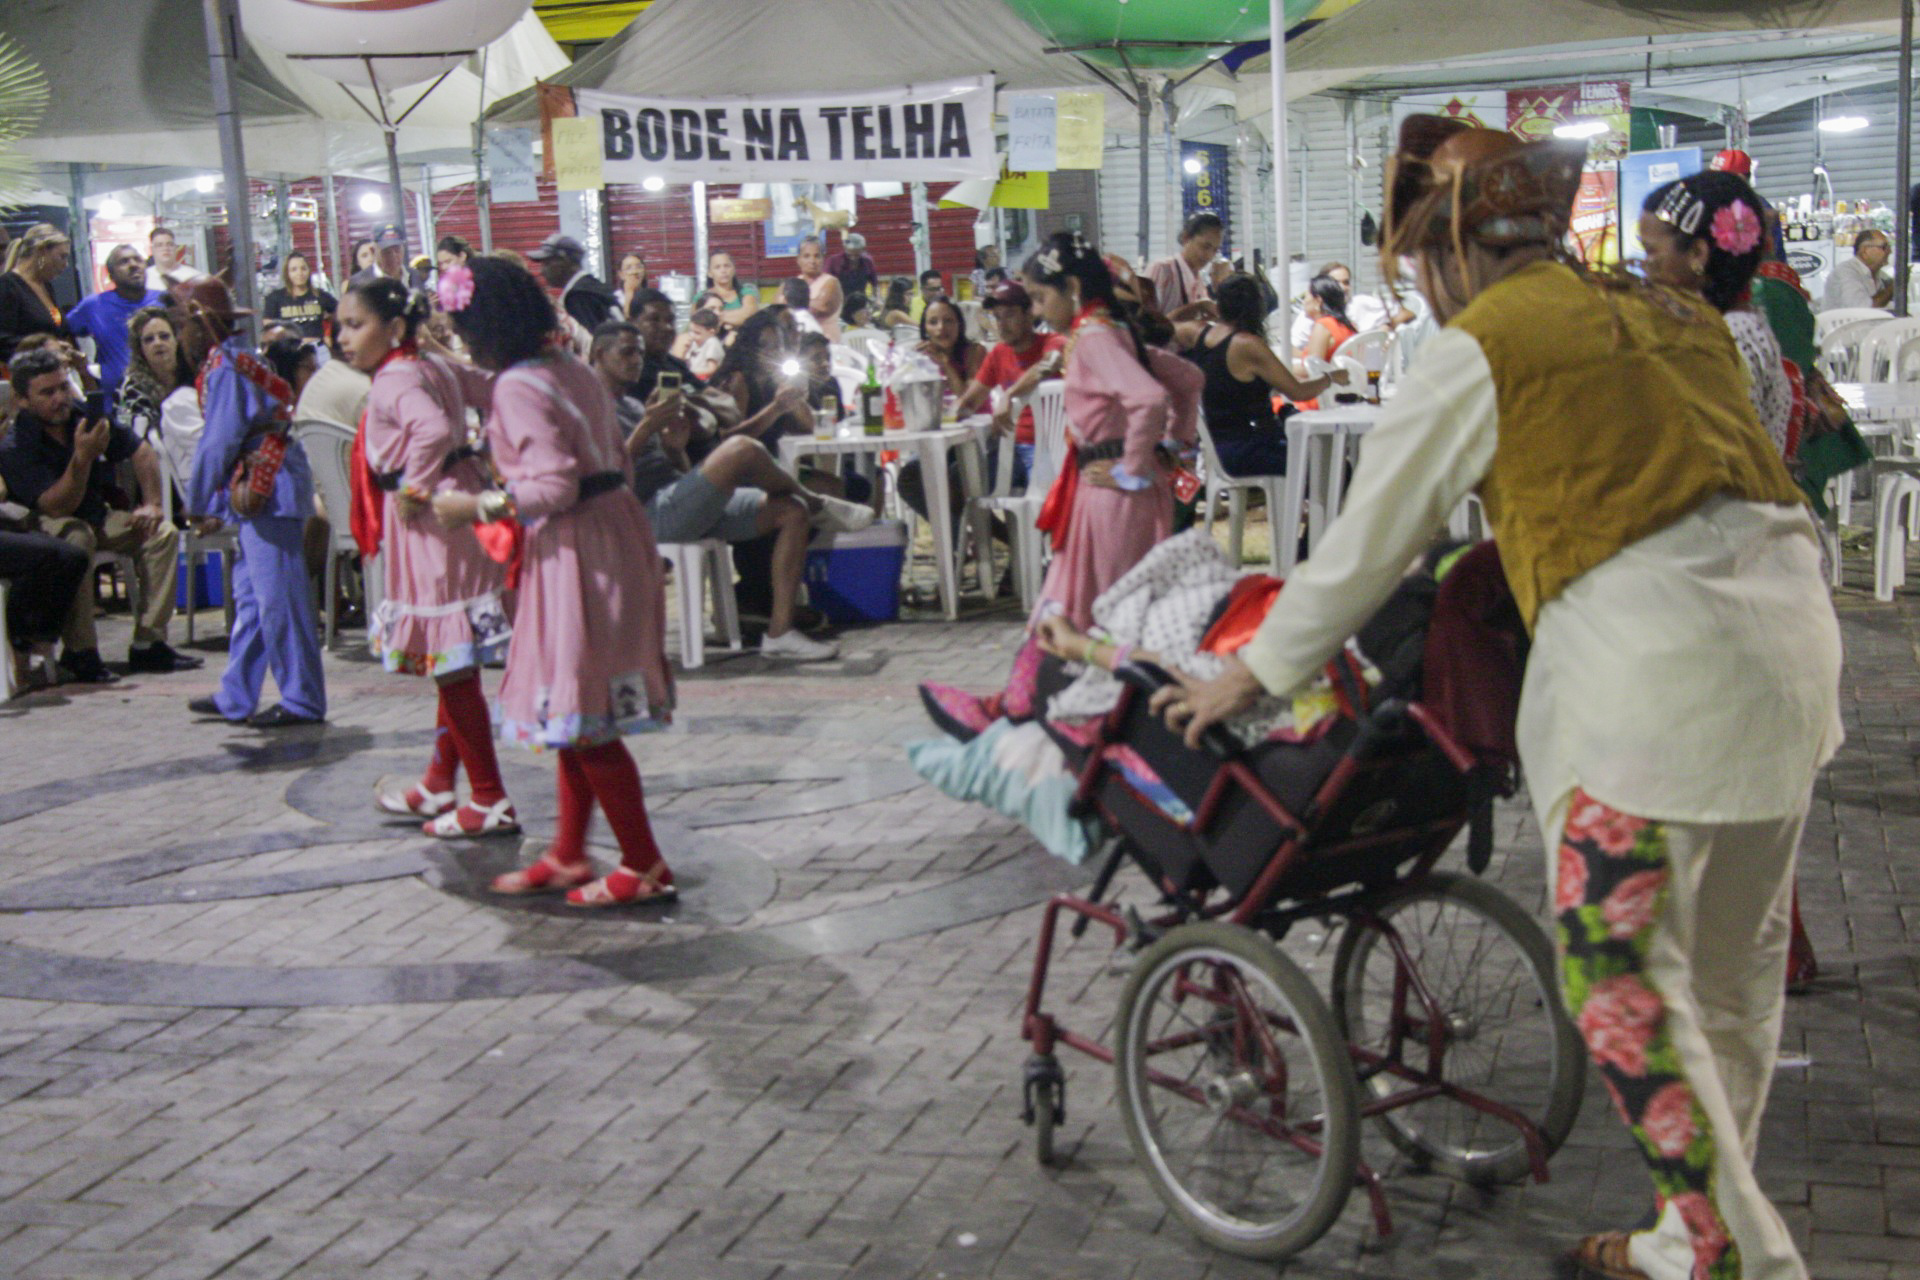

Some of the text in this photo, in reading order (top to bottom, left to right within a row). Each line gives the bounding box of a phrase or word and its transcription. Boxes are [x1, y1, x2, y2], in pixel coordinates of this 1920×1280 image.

[1580, 83, 1619, 98] TEMOS
[601, 102, 972, 162] BODE NA TELHA
